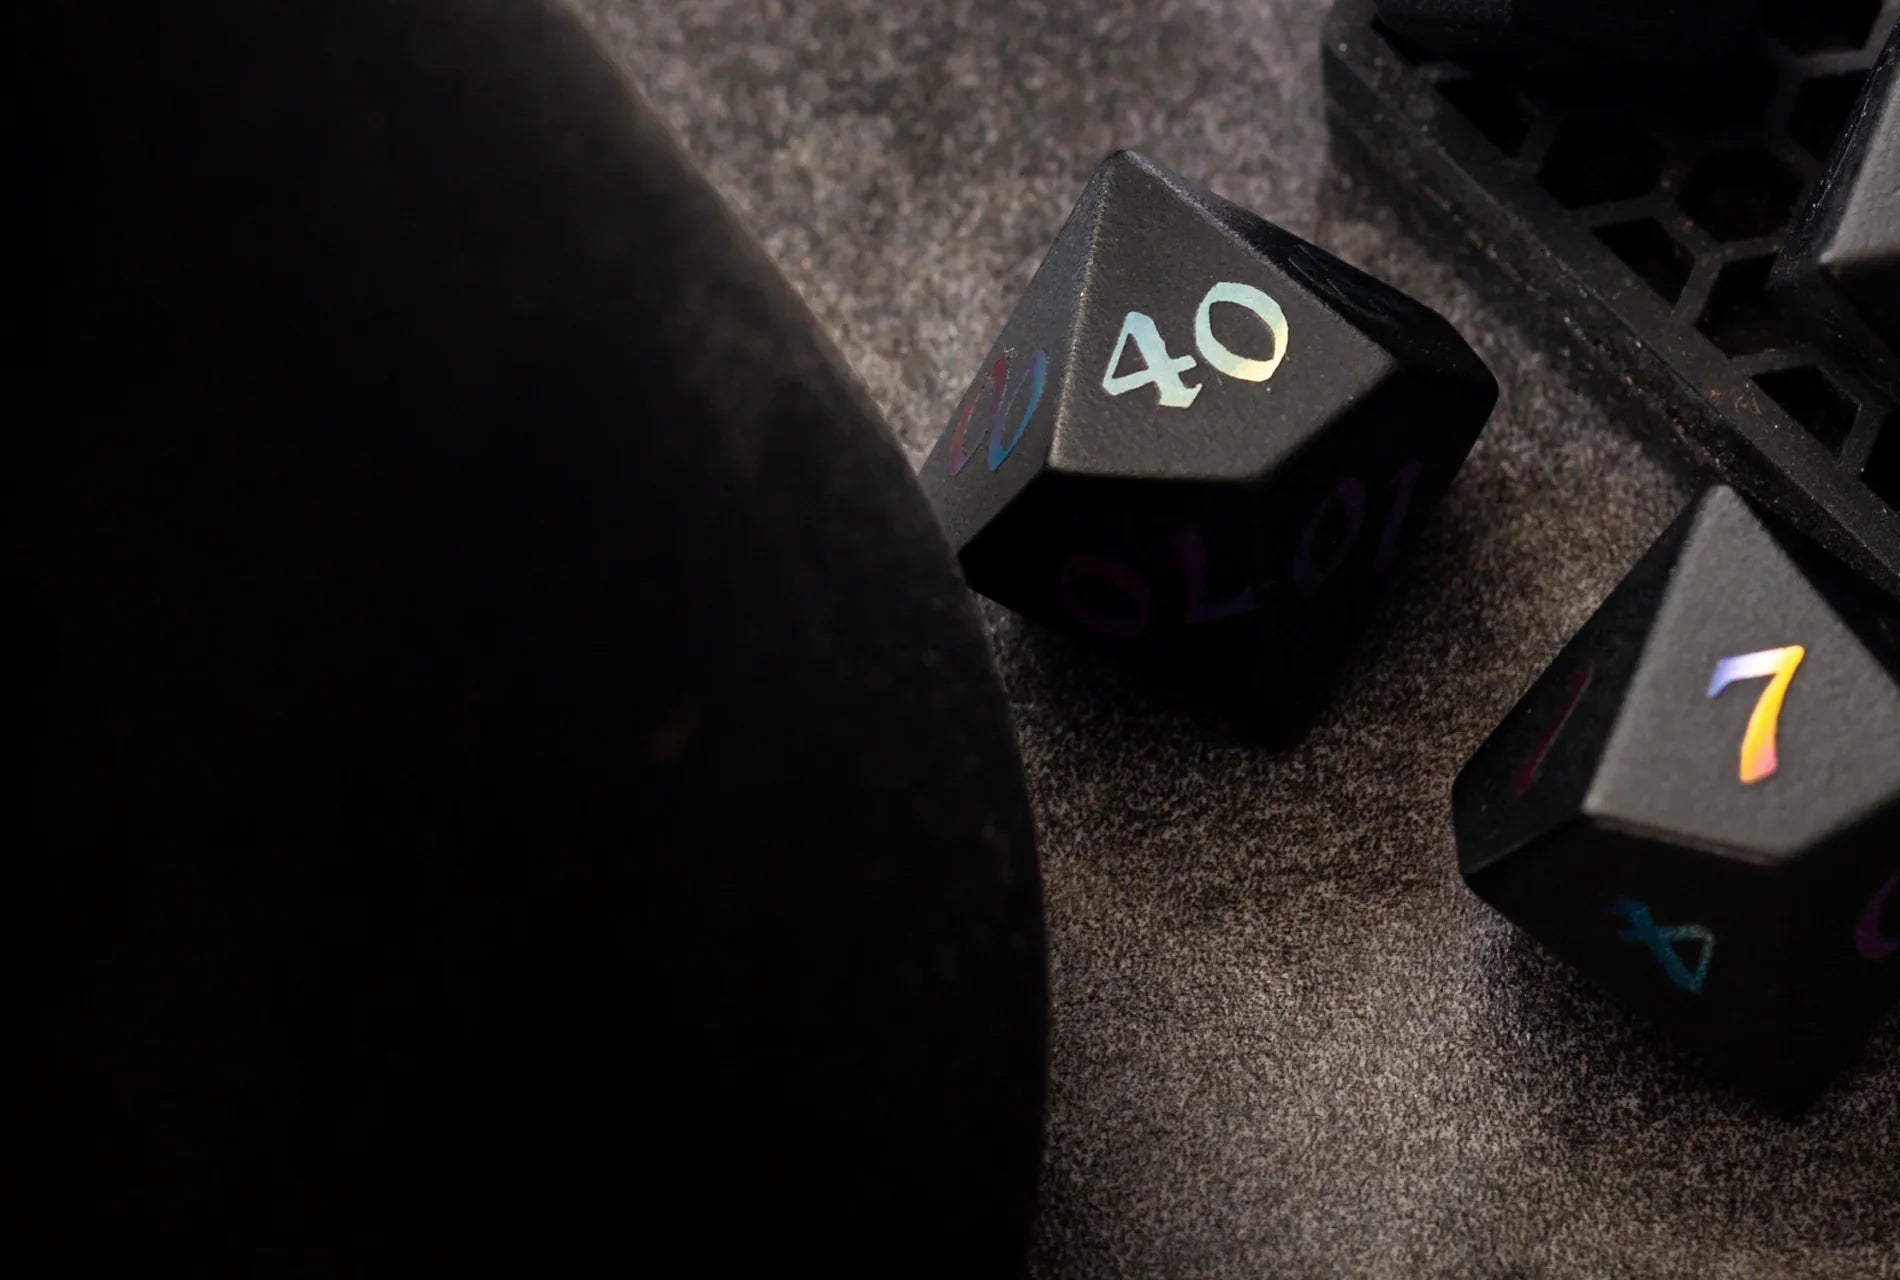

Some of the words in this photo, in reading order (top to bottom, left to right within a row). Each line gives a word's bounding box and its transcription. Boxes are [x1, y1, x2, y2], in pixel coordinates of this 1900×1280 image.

[1102, 280, 1289, 408] 40
[1707, 644, 1805, 784] 7
[1609, 895, 1716, 994] 4
